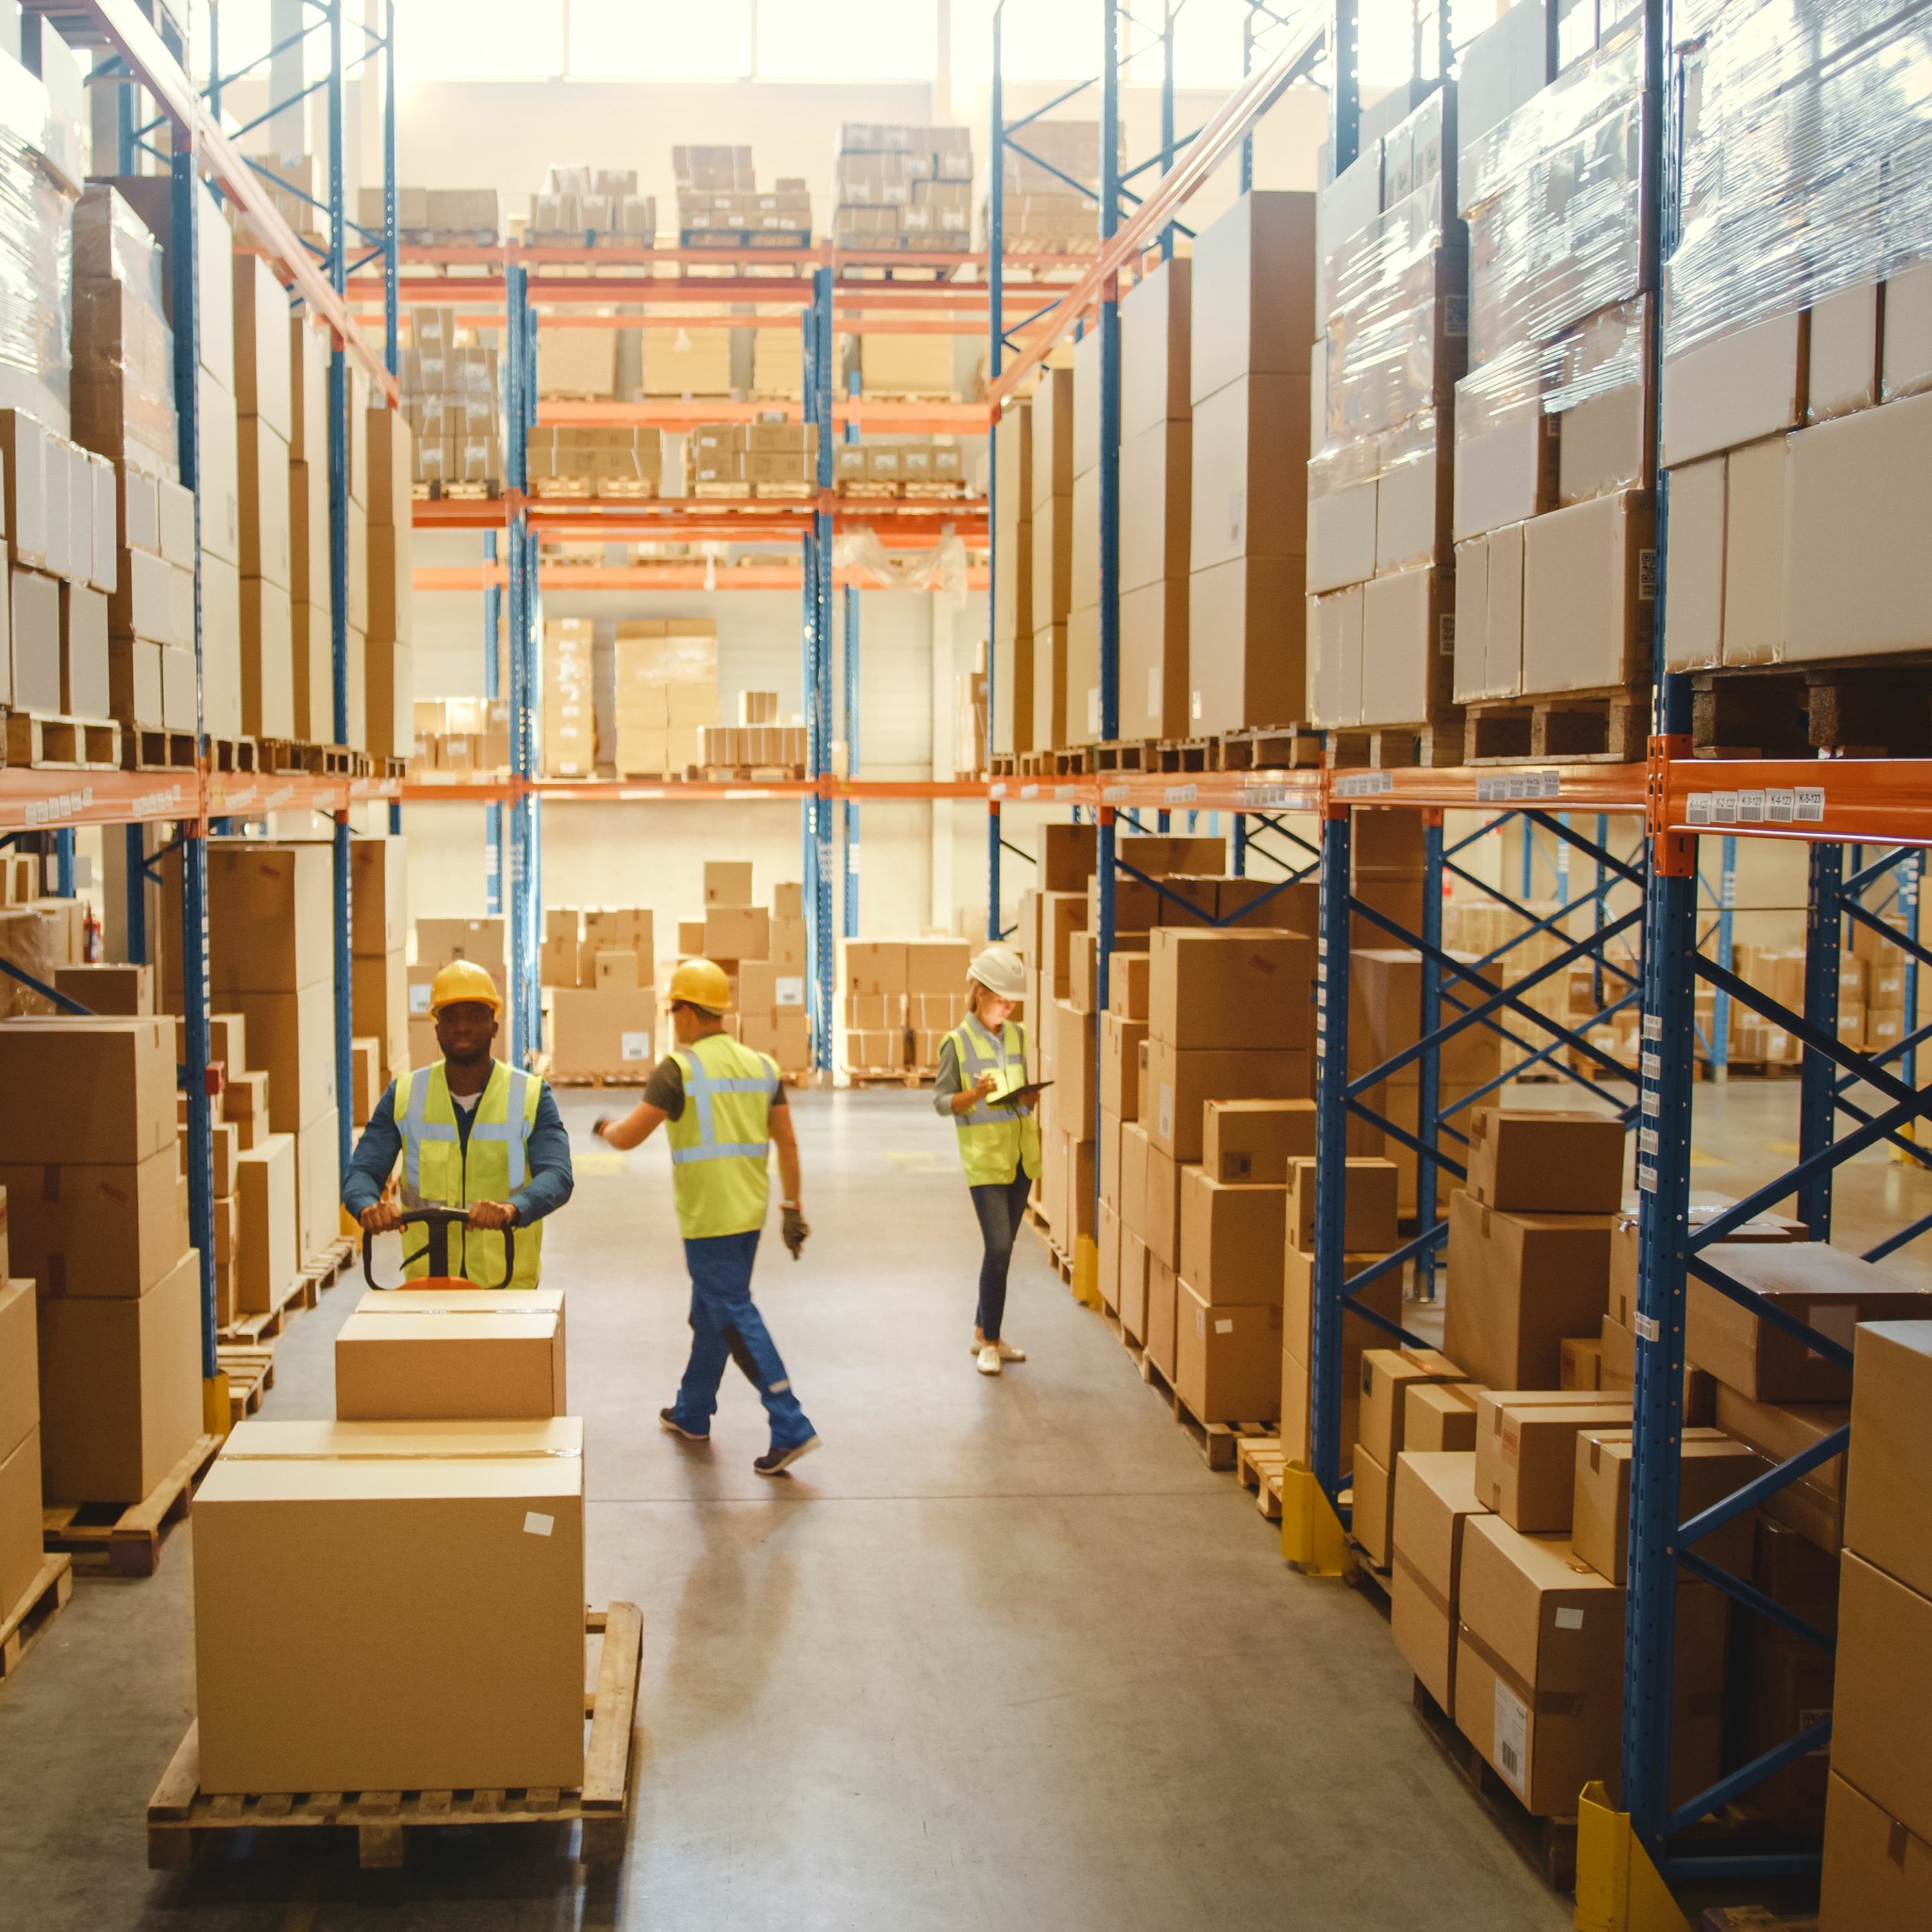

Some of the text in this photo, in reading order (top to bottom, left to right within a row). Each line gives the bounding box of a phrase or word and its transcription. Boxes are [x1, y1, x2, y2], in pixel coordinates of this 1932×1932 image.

[1716, 798, 1735, 808] K-2-123
[1741, 796, 1762, 806] K-3-123
[1770, 795, 1792, 806] K-4-123
[1799, 793, 1821, 804] K-5-123
